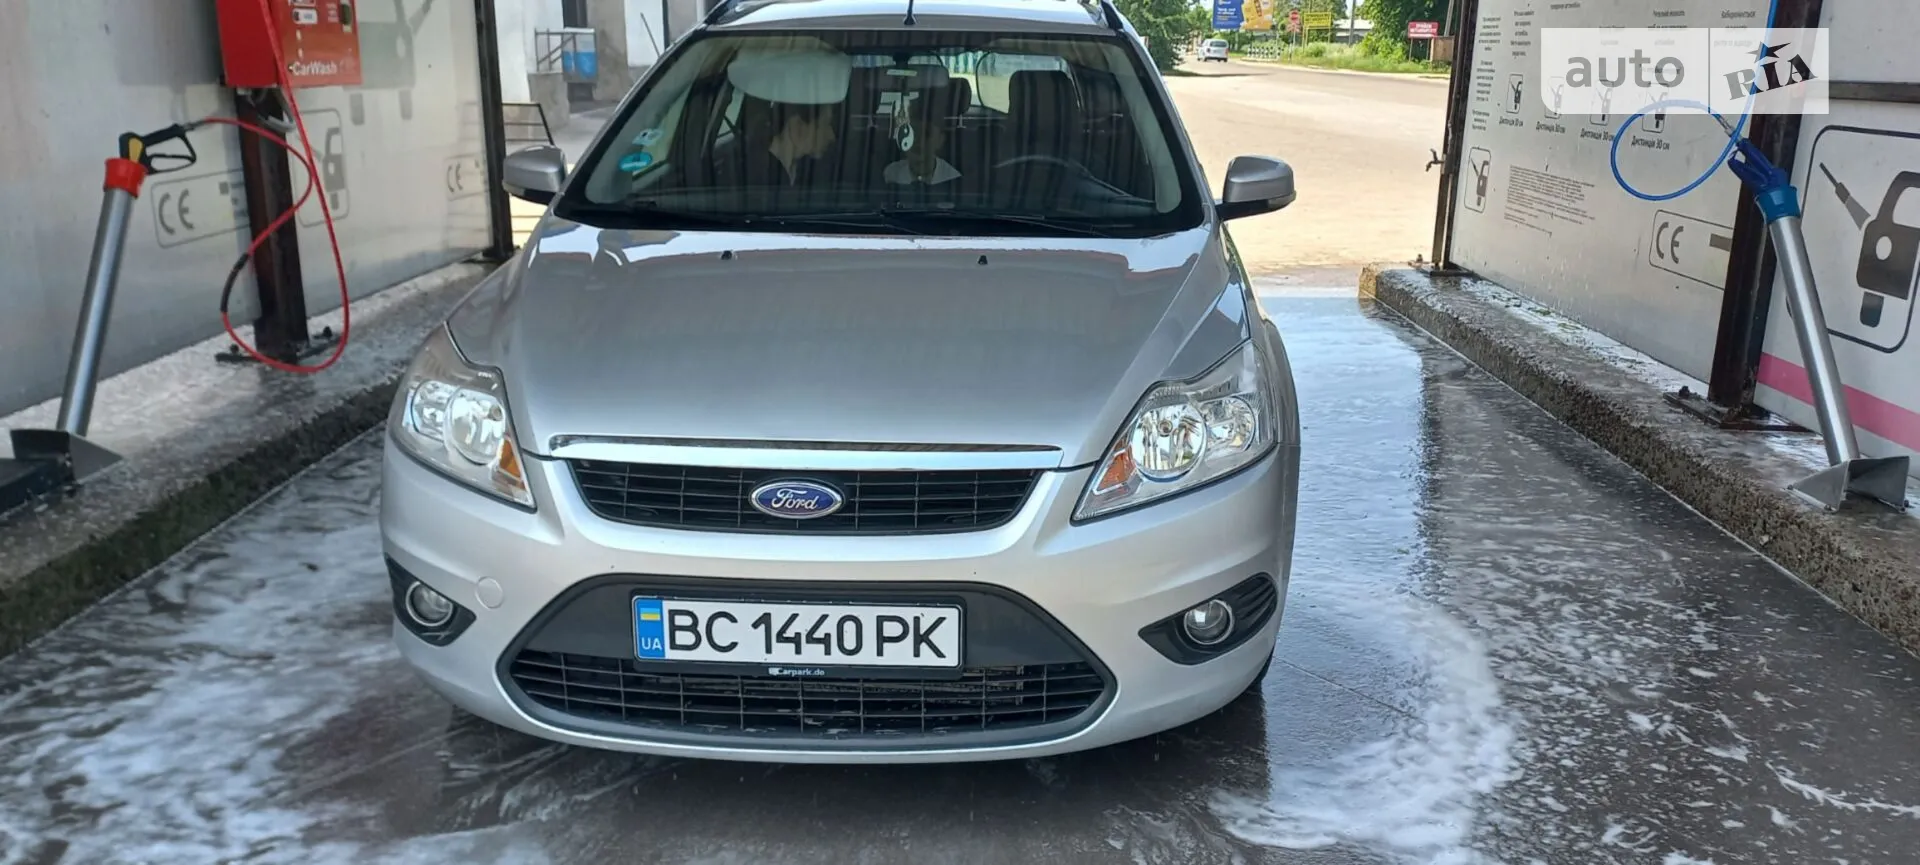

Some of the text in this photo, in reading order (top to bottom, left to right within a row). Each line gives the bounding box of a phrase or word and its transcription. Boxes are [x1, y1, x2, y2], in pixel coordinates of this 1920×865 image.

[293, 61, 337, 76] CarWash
[771, 488, 820, 510] Ford
[668, 609, 948, 659] BC 1440 PK
[641, 637, 663, 650] UA
